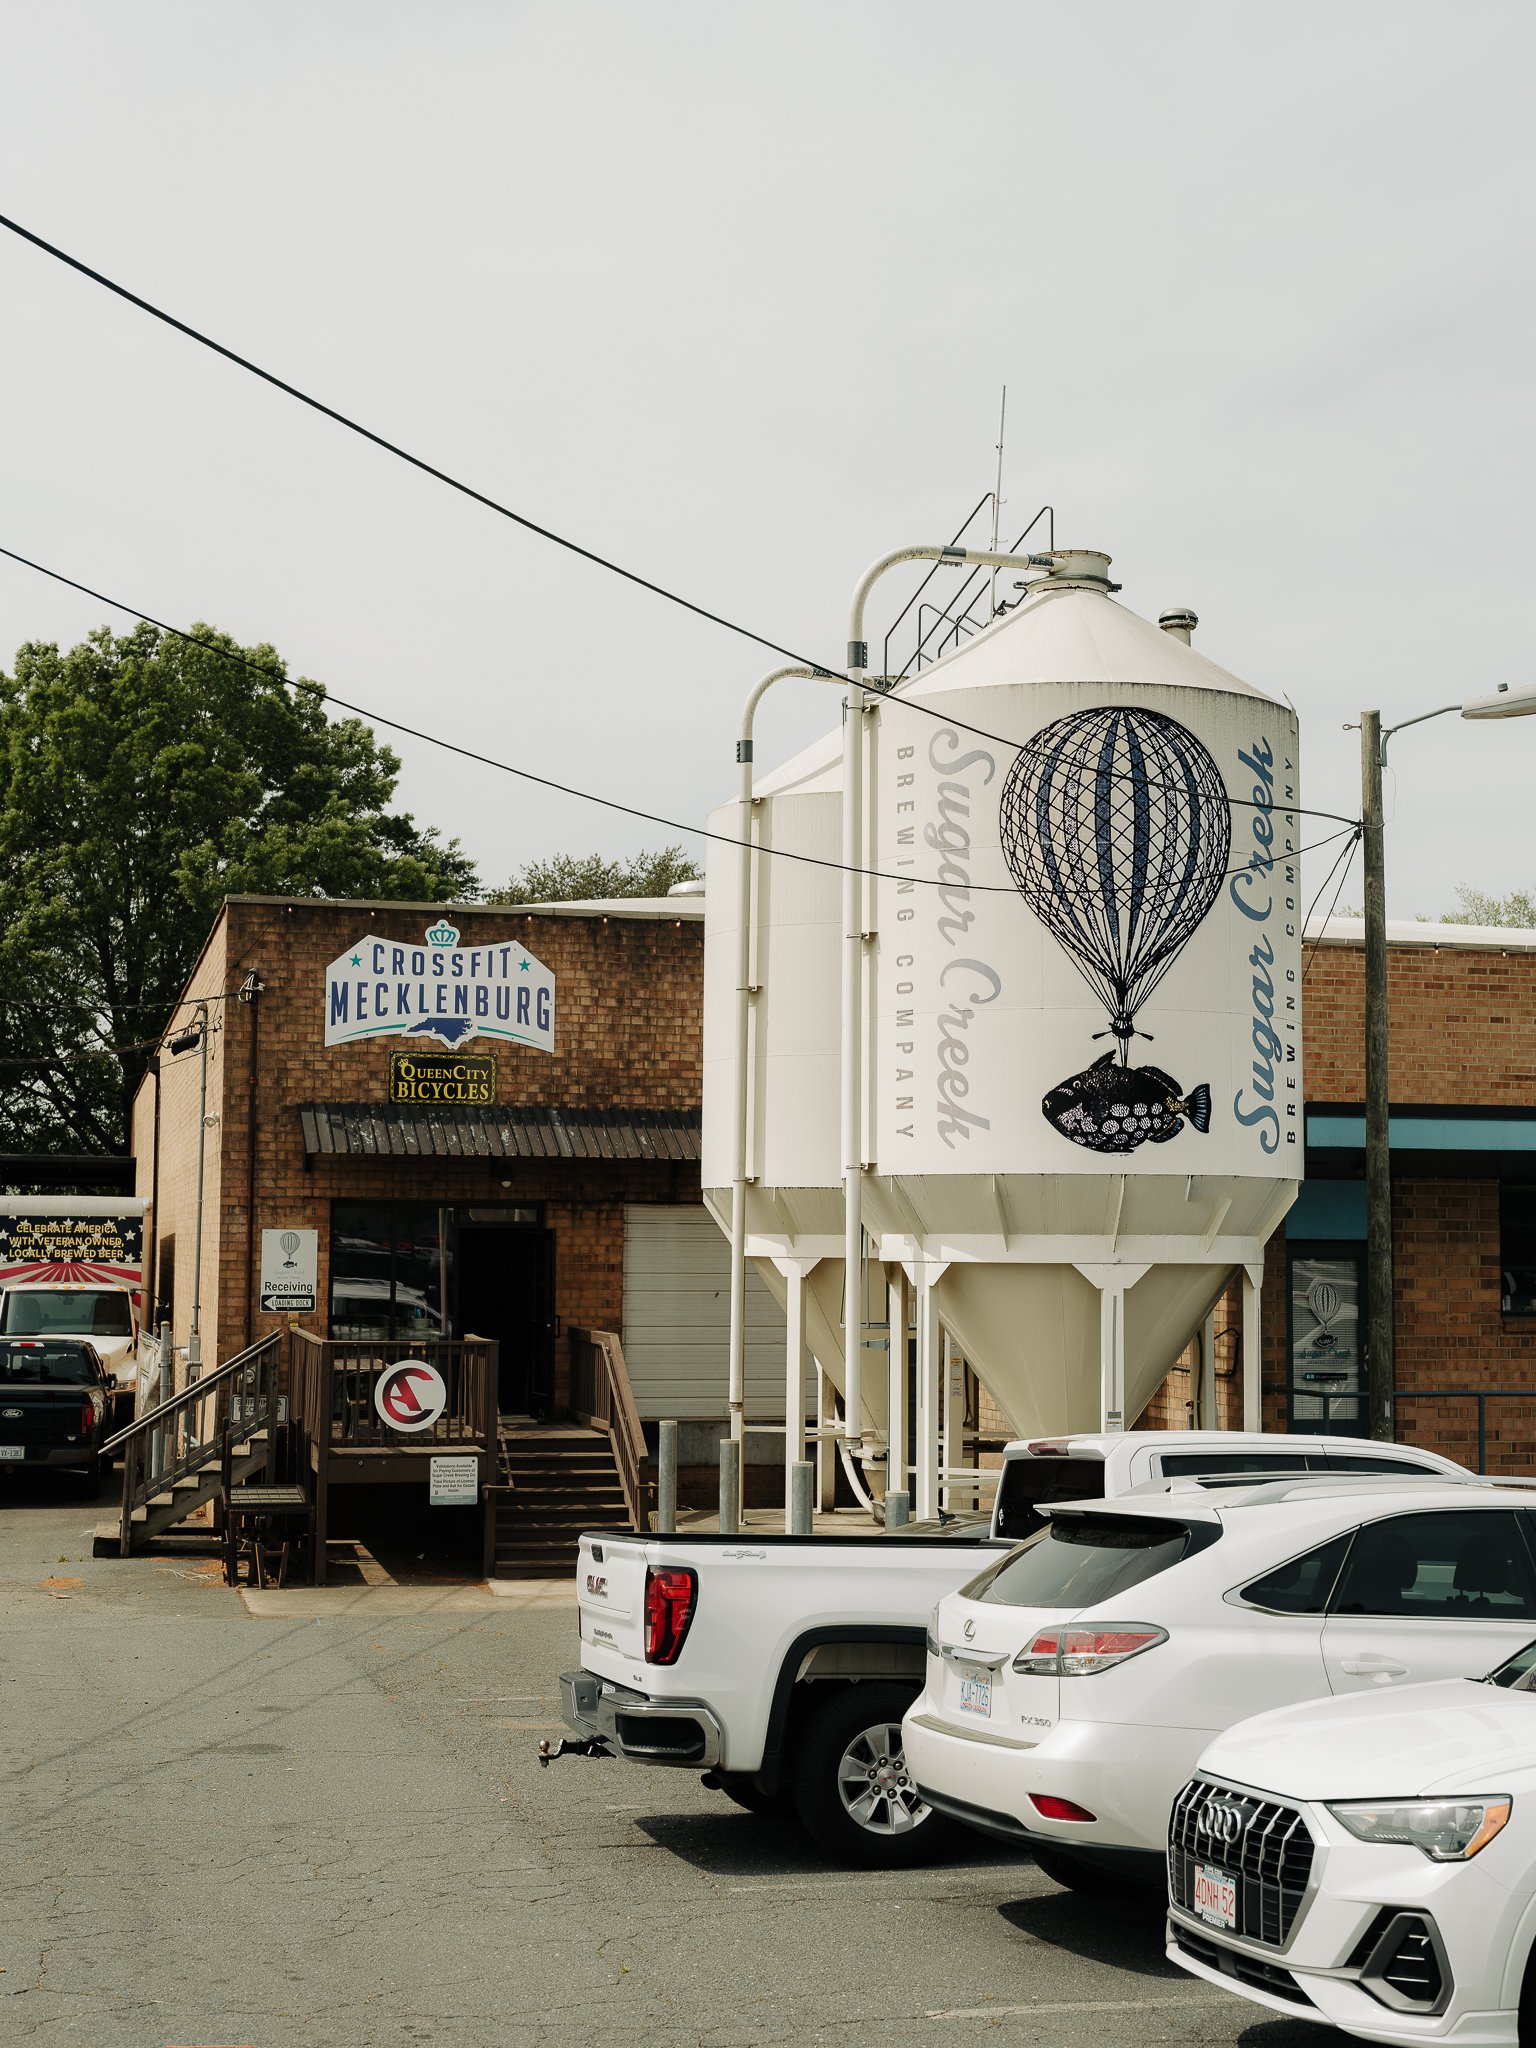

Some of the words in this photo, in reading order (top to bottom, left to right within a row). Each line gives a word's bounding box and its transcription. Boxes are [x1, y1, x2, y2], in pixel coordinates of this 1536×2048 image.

[897, 745, 914, 922] BREWING
[924, 728, 995, 946] Sugar
[1230, 736, 1274, 922] Creek
[1285, 757, 1295, 937] COMPANY
[373, 943, 511, 979] CROSSFIT
[331, 981, 550, 1032] MECKLENBURG
[896, 954, 914, 1138] COMPANY
[937, 958, 1001, 1150] Creek
[1233, 933, 1283, 1154] Sugar
[1286, 969, 1296, 1144] BREWING
[397, 1081, 489, 1100] BICYCLES
[9, 1236, 35, 1246] WITH
[37, 1236, 84, 1246] VETERAN
[85, 1237, 125, 1247] OWNED,
[16, 1224, 71, 1233] CELEBRATE
[74, 1225, 118, 1234] AMERICA
[9, 1249, 54, 1258] LOCALLY
[55, 1249, 96, 1258] BREWED
[98, 1249, 124, 1258] BEER
[264, 1282, 313, 1293] Receiving
[296, 1299, 310, 1307] DOCK
[587, 1574, 608, 1598] GMC
[1196, 1877, 1218, 1911] 4DNH
[1222, 1887, 1234, 1917] 52
